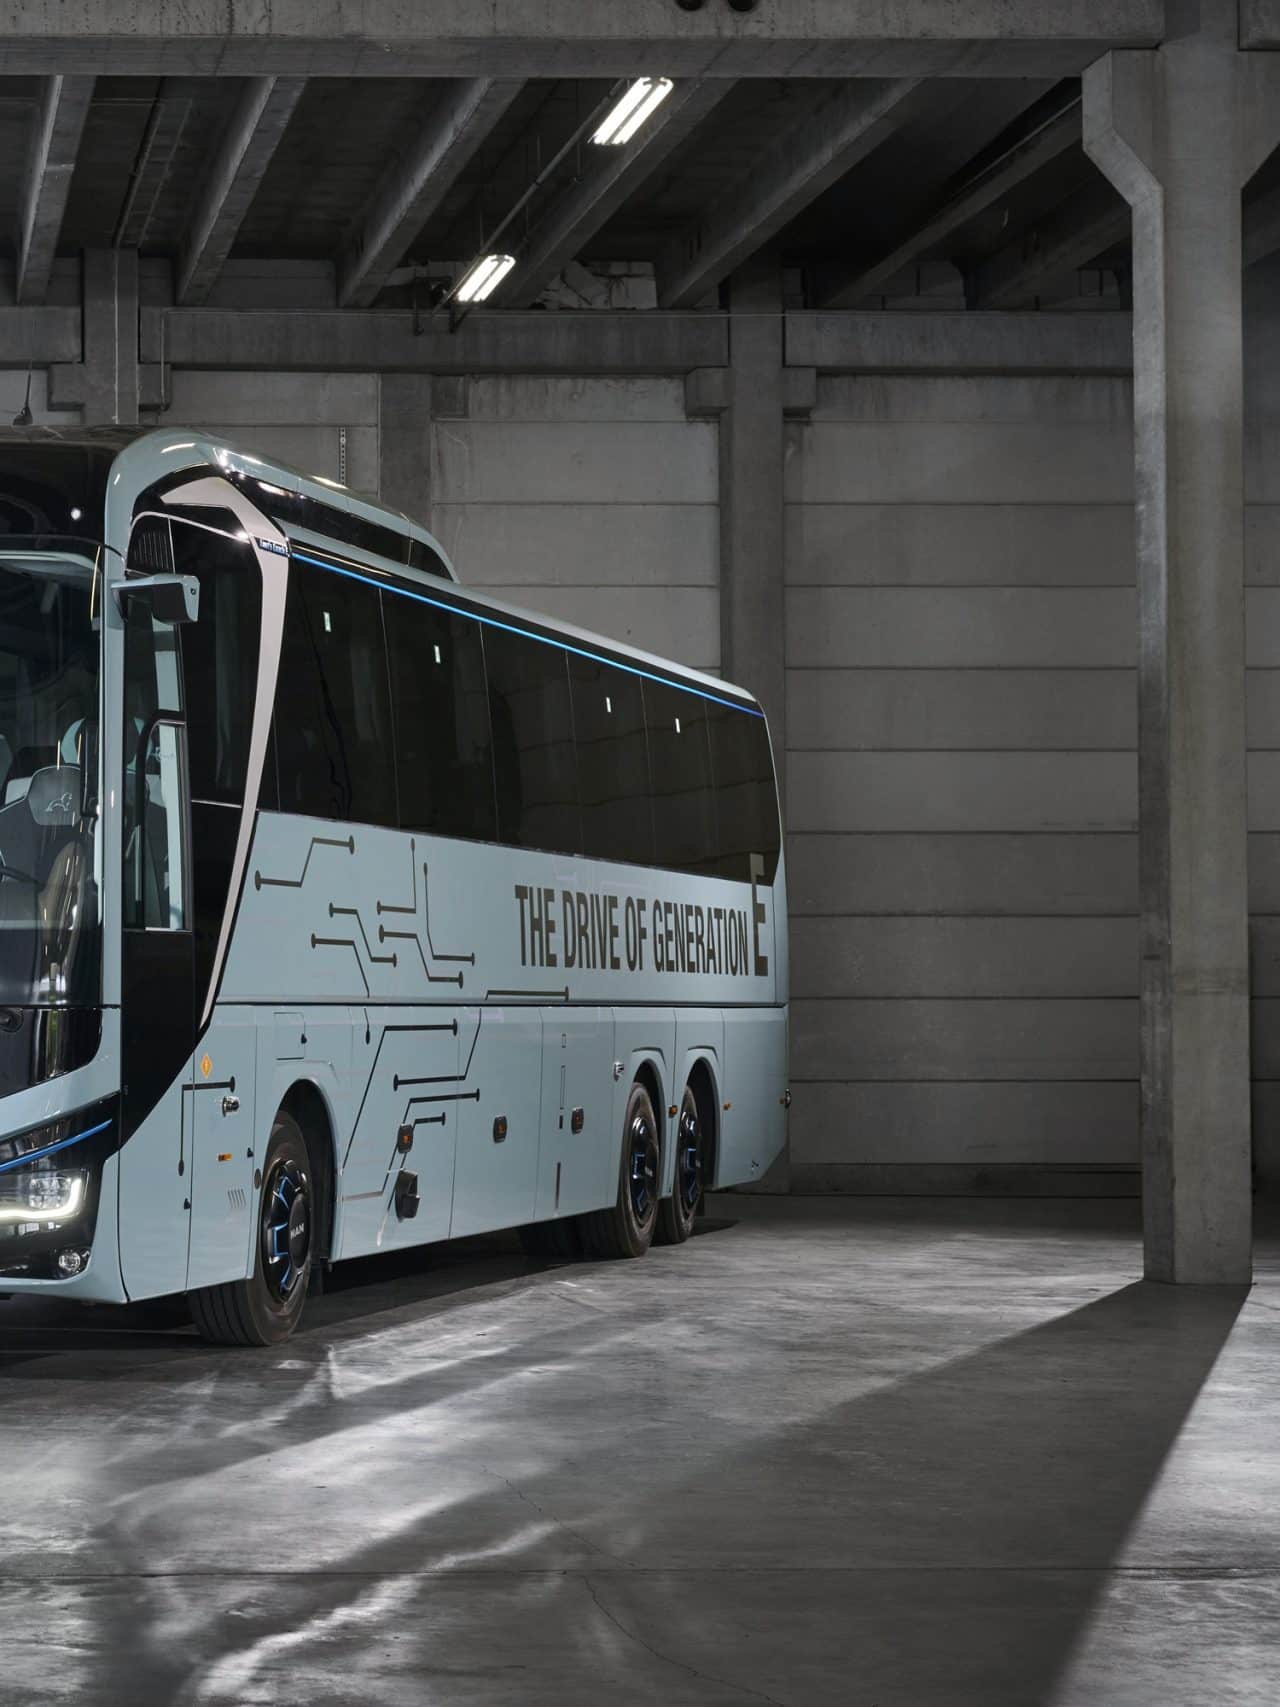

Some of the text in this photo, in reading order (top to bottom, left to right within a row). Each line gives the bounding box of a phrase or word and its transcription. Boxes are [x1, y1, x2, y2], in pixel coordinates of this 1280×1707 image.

[514, 853, 769, 977] THE DRIVE OF GENERATION E
[290, 1223, 304, 1241] MAN
